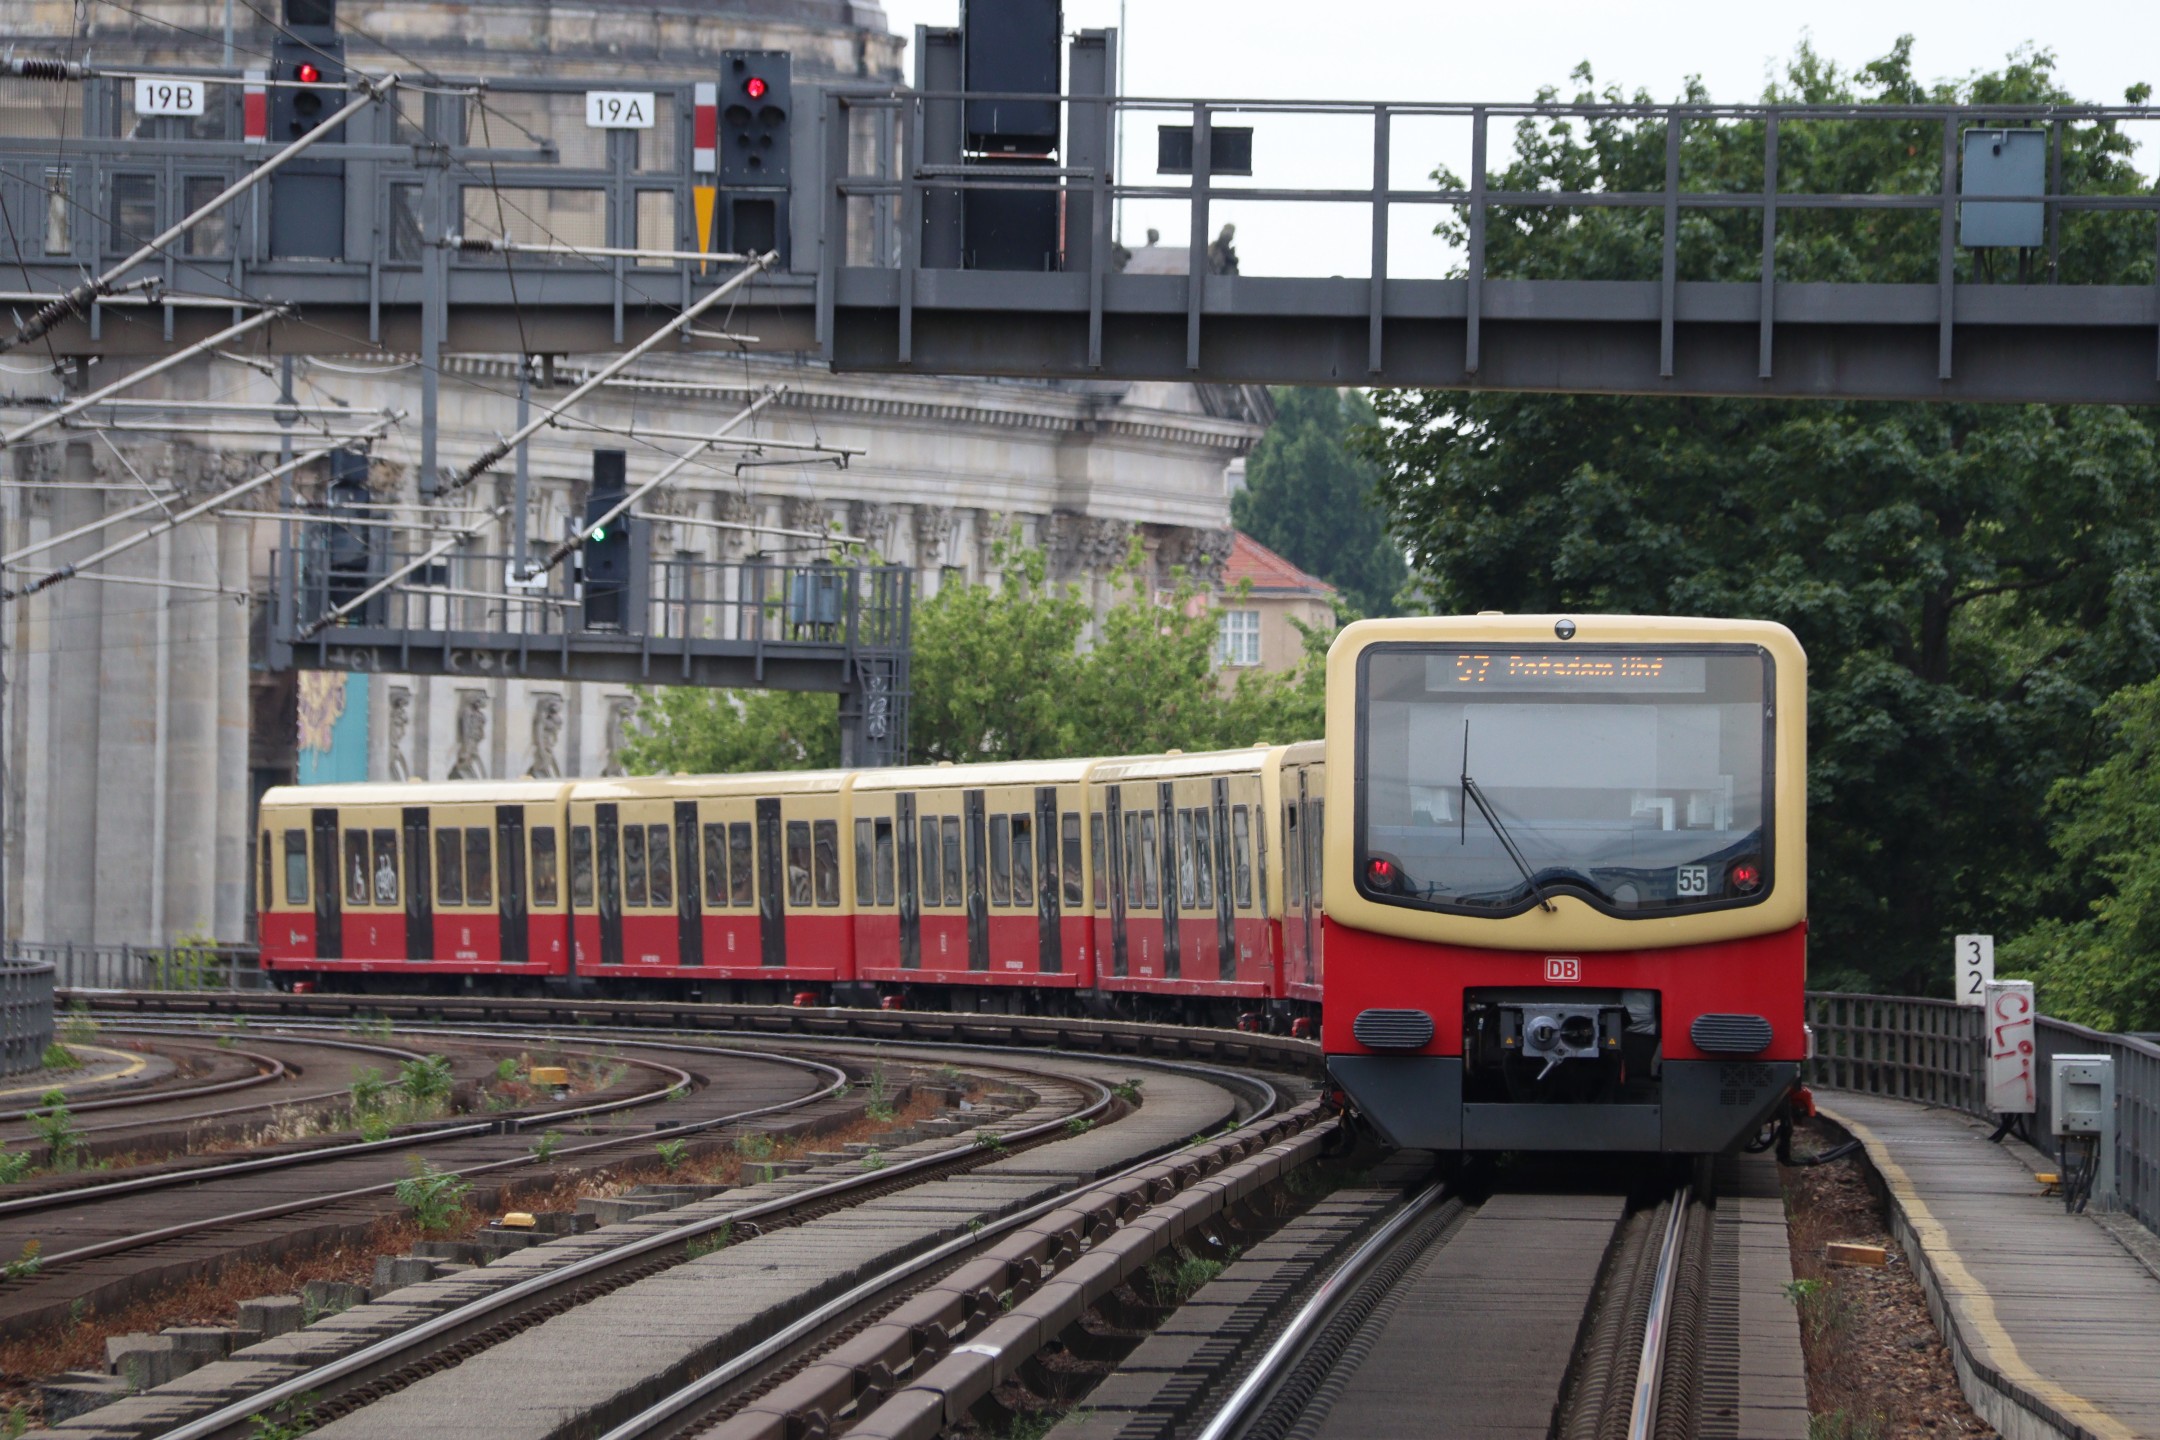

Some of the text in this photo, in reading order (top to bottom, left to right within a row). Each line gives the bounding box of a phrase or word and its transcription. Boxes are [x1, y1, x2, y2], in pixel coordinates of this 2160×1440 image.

[146, 85, 193, 110] 19B
[597, 98, 643, 122] 19A
[1456, 655, 1490, 682] S7
[1679, 869, 1705, 892] 55
[1968, 941, 1981, 965] 3
[1549, 960, 1577, 978] DB
[1968, 970, 1983, 994] 2
